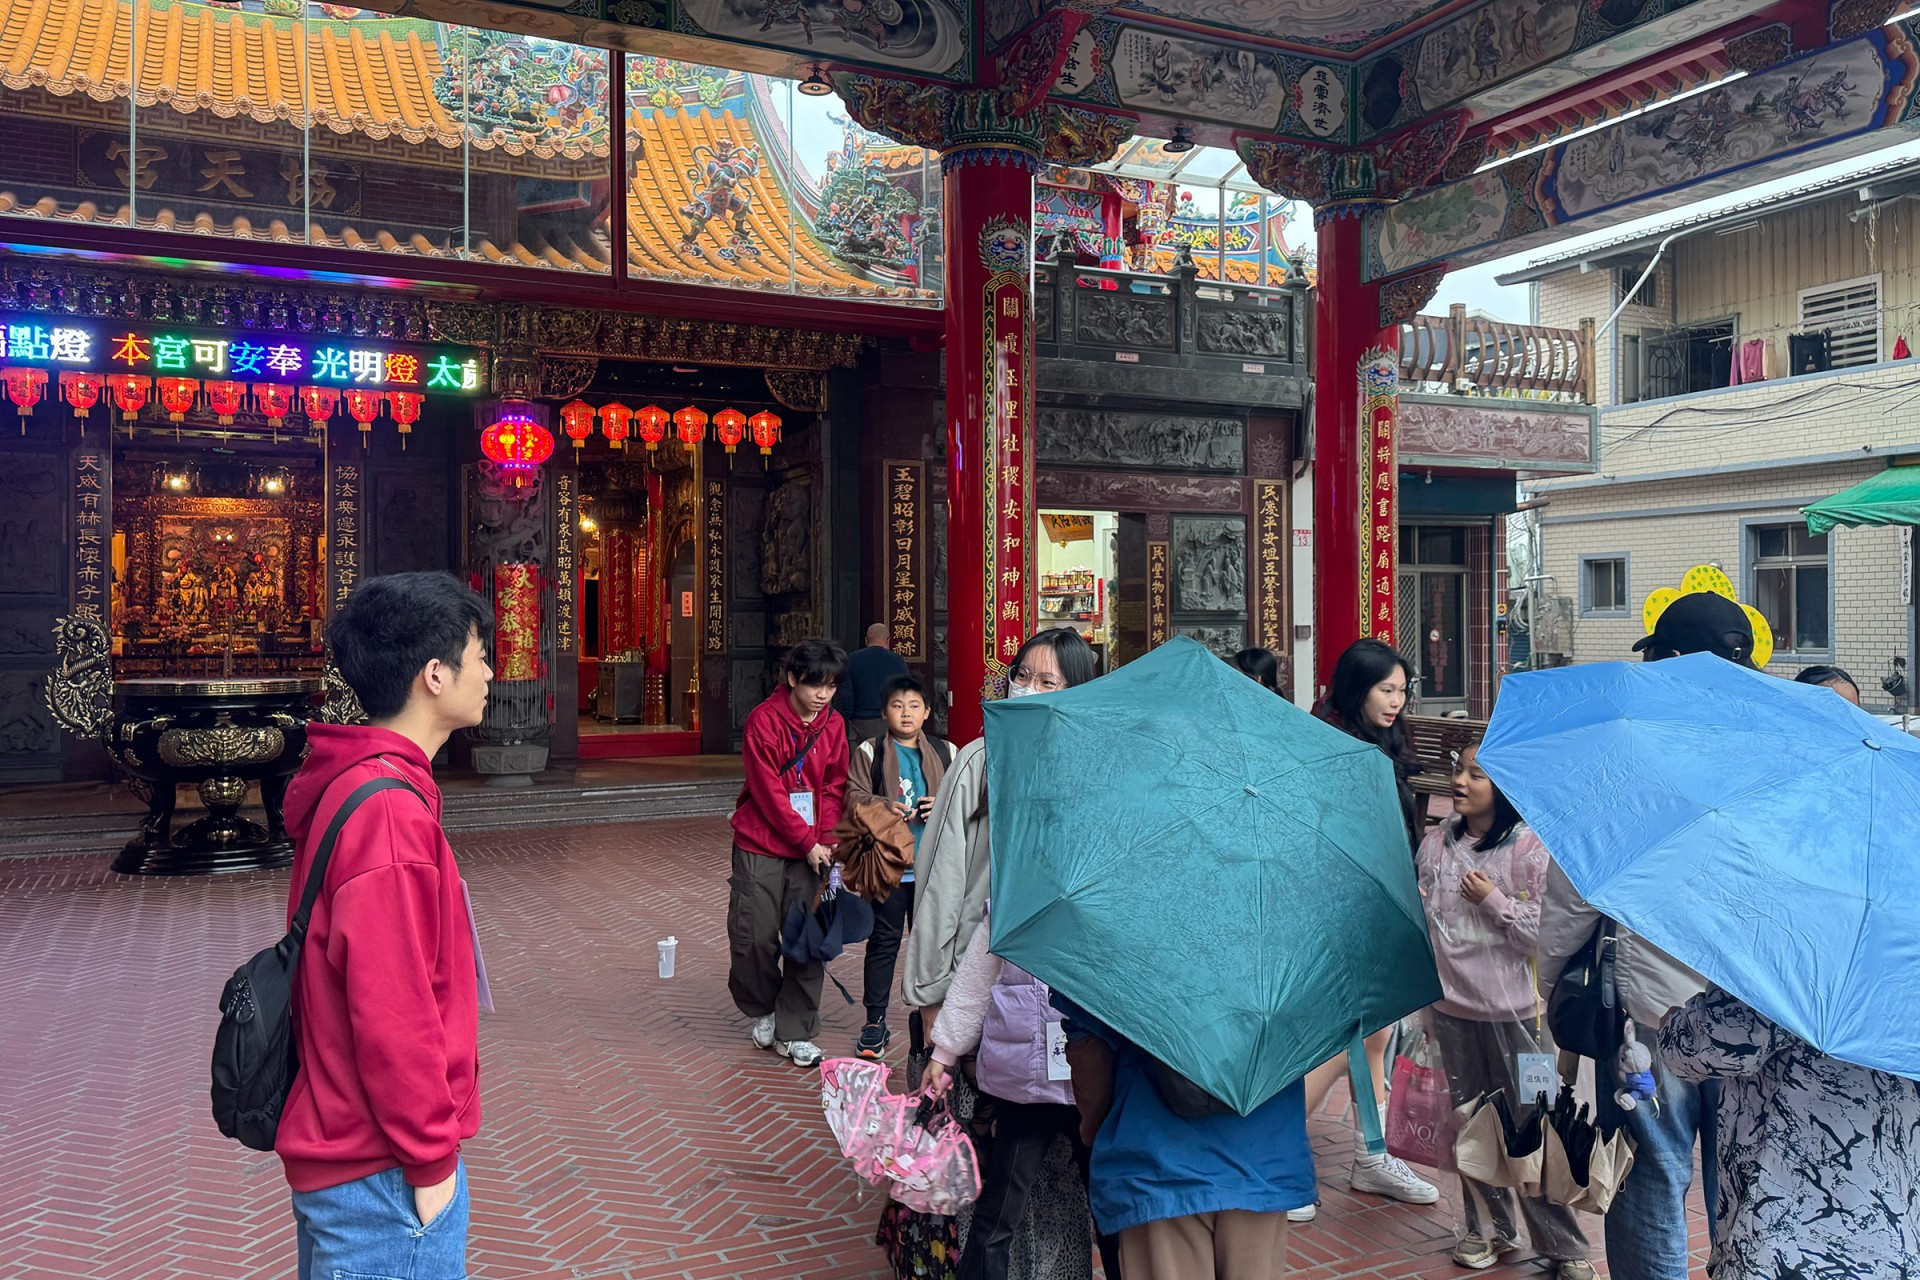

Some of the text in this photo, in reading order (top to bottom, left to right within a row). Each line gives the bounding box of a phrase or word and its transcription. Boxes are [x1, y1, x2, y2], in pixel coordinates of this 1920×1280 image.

[1312, 69, 1332, 131] 慈雲濟世
[0, 324, 91, 363] 點燈
[112, 332, 302, 377] 本宮可安奉
[312, 346, 418, 384] 光明燈
[334, 465, 359, 611] 協法無邊永護蒼生
